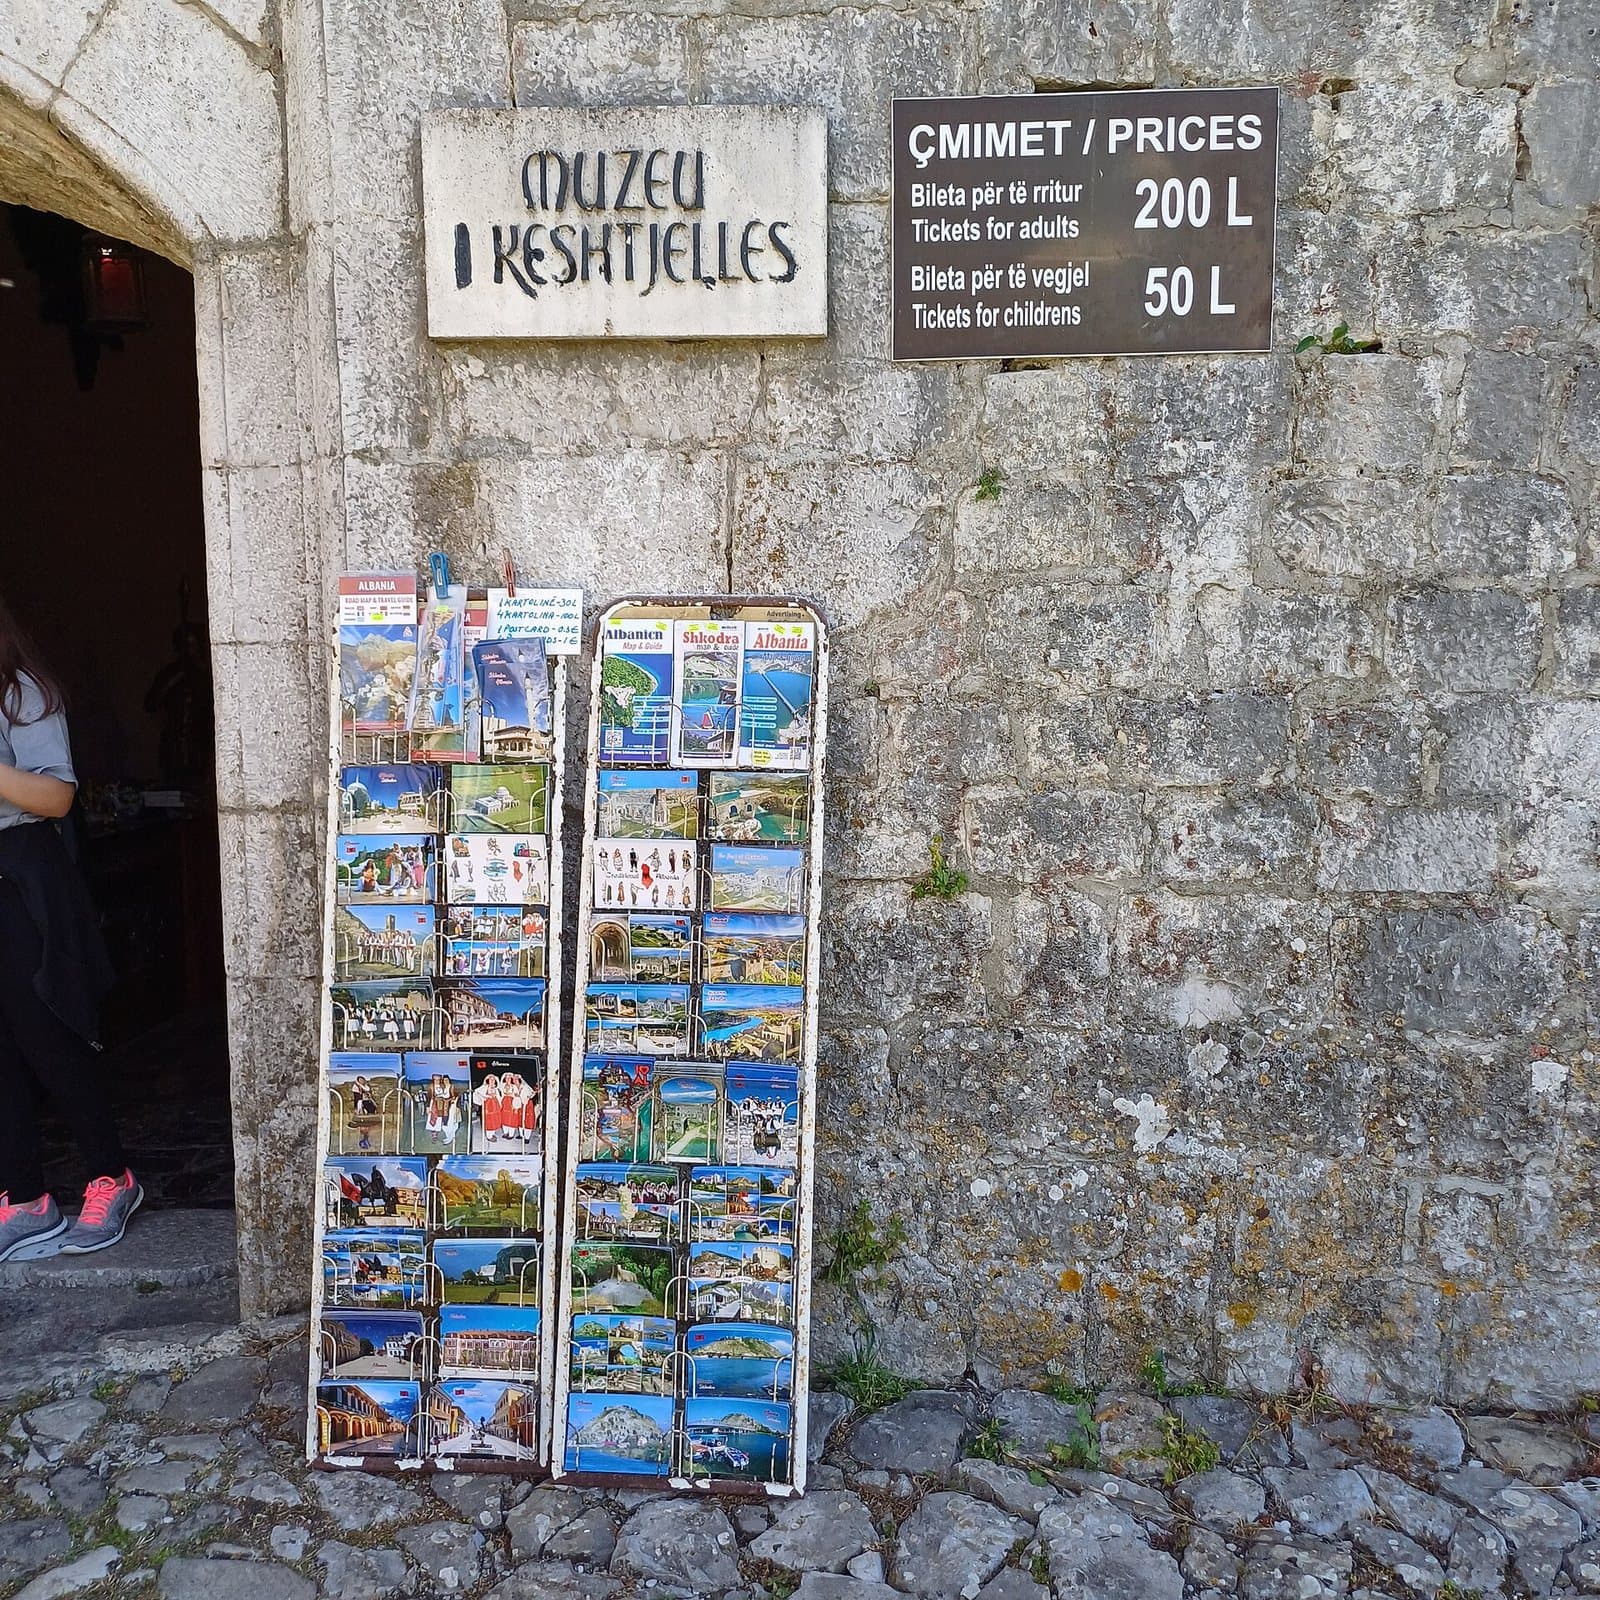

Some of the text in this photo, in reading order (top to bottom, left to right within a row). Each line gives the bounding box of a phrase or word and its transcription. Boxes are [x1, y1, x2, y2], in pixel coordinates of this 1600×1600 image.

[909, 114, 1263, 168] ÇMIMET / PRICES
[521, 149, 706, 212] MUZEU
[911, 181, 1083, 211] Bileta për të rritur
[1134, 176, 1253, 229] 200 L
[912, 214, 1080, 242] Tickets for adults
[453, 219, 800, 299] I KESHTJELLES
[911, 261, 1090, 296] Bileta për të vegjel
[1144, 265, 1237, 318] 50 L
[912, 300, 1081, 329] Tickets for childrens
[358, 581, 396, 591] ALBANIA
[622, 641, 637, 651] Map
[645, 641, 663, 650] Guide
[683, 631, 739, 644] Shkodra
[753, 633, 808, 649] Albania
